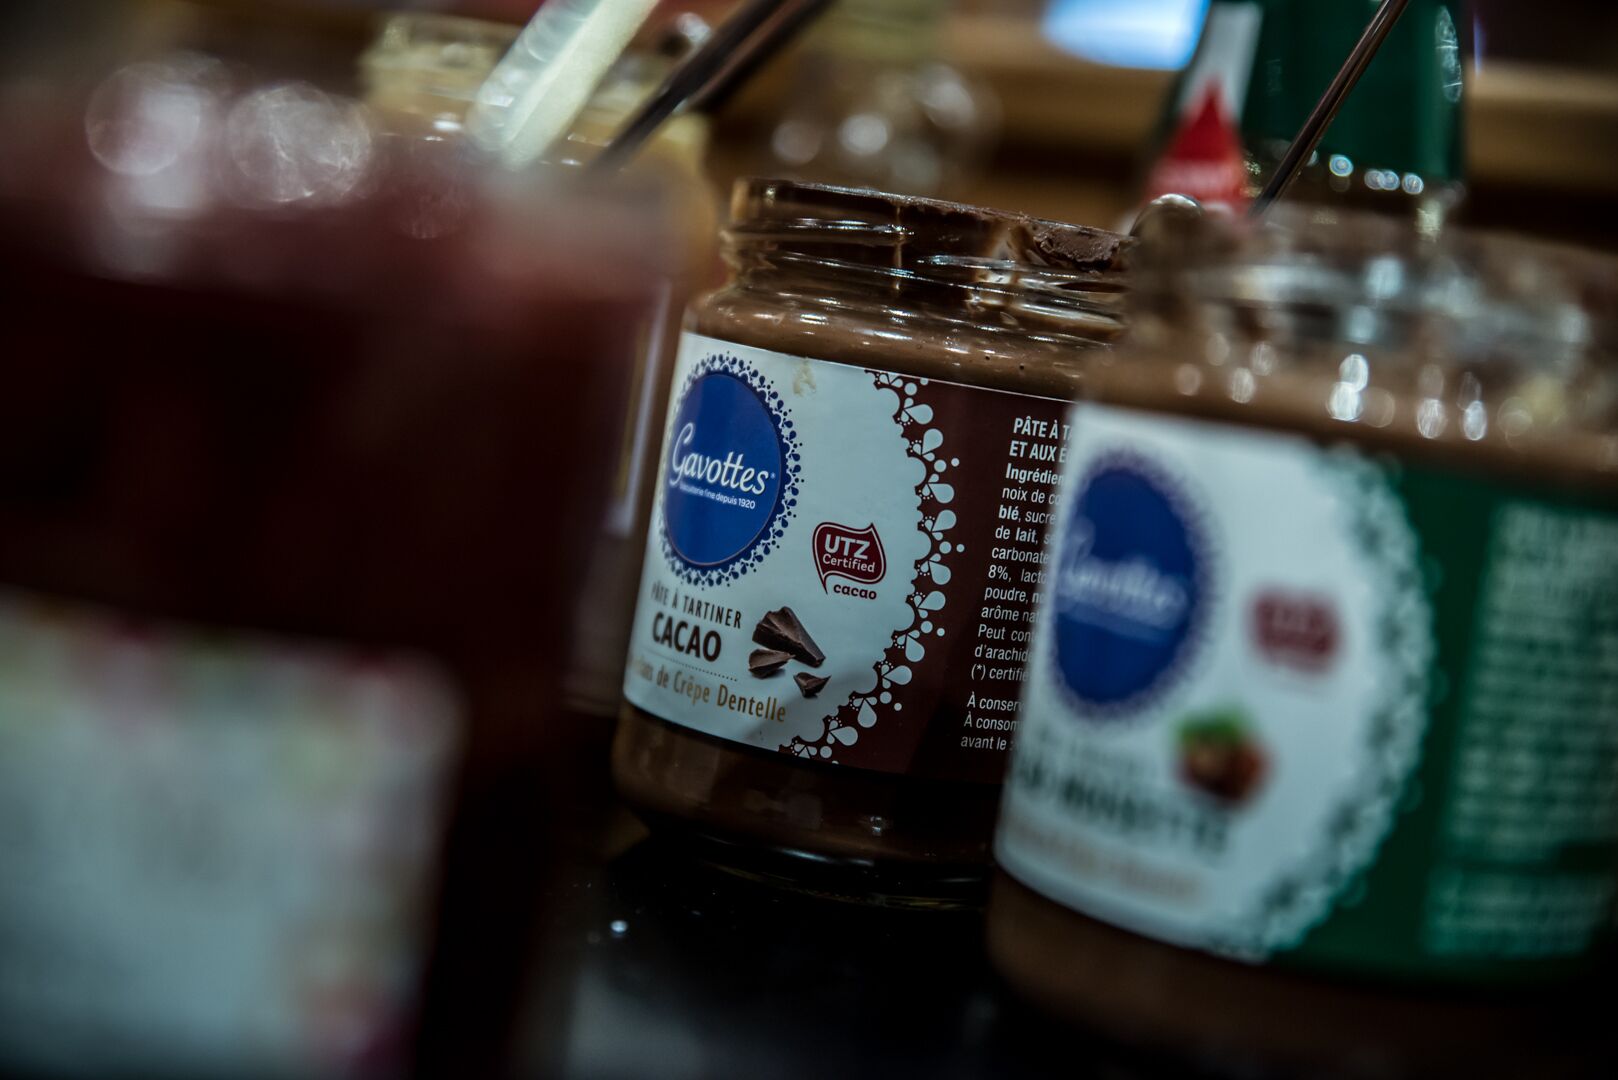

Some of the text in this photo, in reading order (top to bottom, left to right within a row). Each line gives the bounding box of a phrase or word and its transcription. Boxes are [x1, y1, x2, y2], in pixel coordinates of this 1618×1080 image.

[1013, 415, 1048, 438] PÂTE
[1049, 419, 1059, 440] À
[669, 422, 769, 495] Gavottes
[1009, 440, 1028, 458] ET
[1029, 443, 1057, 462] AUX
[716, 492, 737, 506] depuis
[738, 498, 756, 510] 1920
[1001, 486, 1028, 502] noix
[1031, 488, 1046, 504] de
[998, 504, 1021, 523] blé,
[995, 525, 1011, 540] de
[1015, 527, 1038, 545] lait,
[824, 533, 871, 560] UTZ
[822, 553, 876, 573] Certified
[988, 564, 1012, 583] 8%,
[833, 584, 877, 600] cacao
[984, 587, 1028, 605] poudre,
[682, 595, 742, 629] TARTINER
[981, 604, 1020, 621] arôme
[652, 611, 722, 662] CACAO
[978, 623, 1006, 641] Peut
[656, 664, 669, 689] de
[673, 669, 710, 706] Crêpe
[717, 684, 786, 723] Dentelle
[967, 691, 976, 709] À
[964, 711, 973, 728] À
[960, 736, 994, 750] avant
[997, 736, 1007, 751] le
